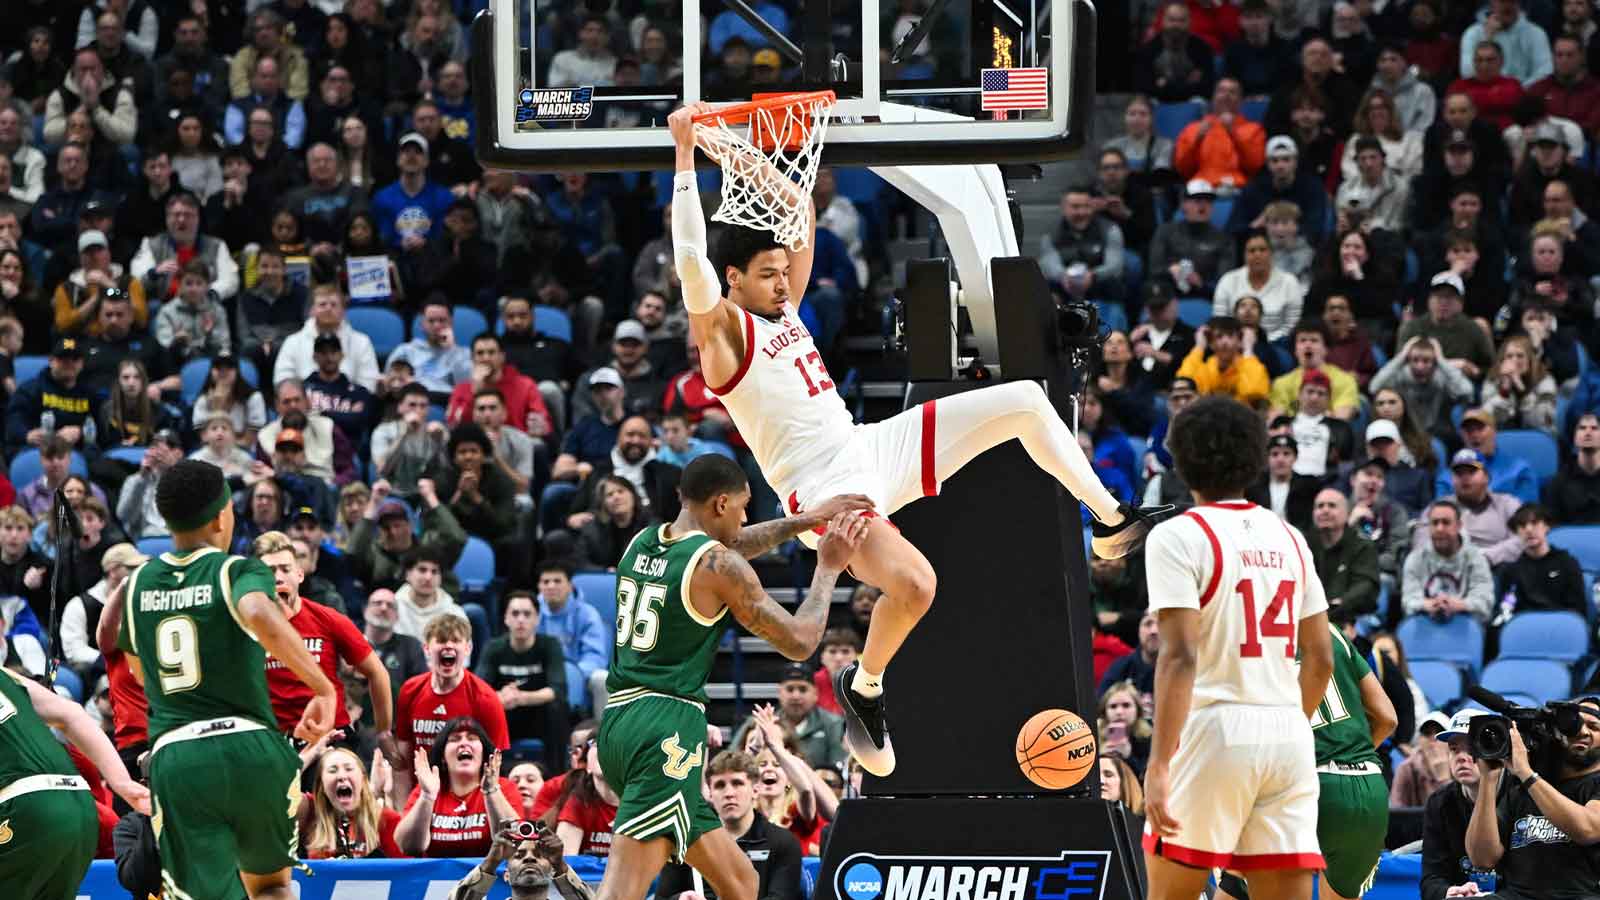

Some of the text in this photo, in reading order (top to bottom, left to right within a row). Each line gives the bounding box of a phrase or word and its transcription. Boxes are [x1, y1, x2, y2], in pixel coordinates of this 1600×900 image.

[532, 91, 572, 104] MARCH
[537, 103, 590, 116] MADNESS
[794, 350, 833, 398] 13
[632, 553, 668, 577] NELSON
[140, 584, 212, 612] HIGHTOWER
[1235, 579, 1296, 658] 14
[156, 615, 202, 695] 9
[1068, 742, 1095, 760] NCAA
[847, 866, 1029, 900] NCAA MARCH
